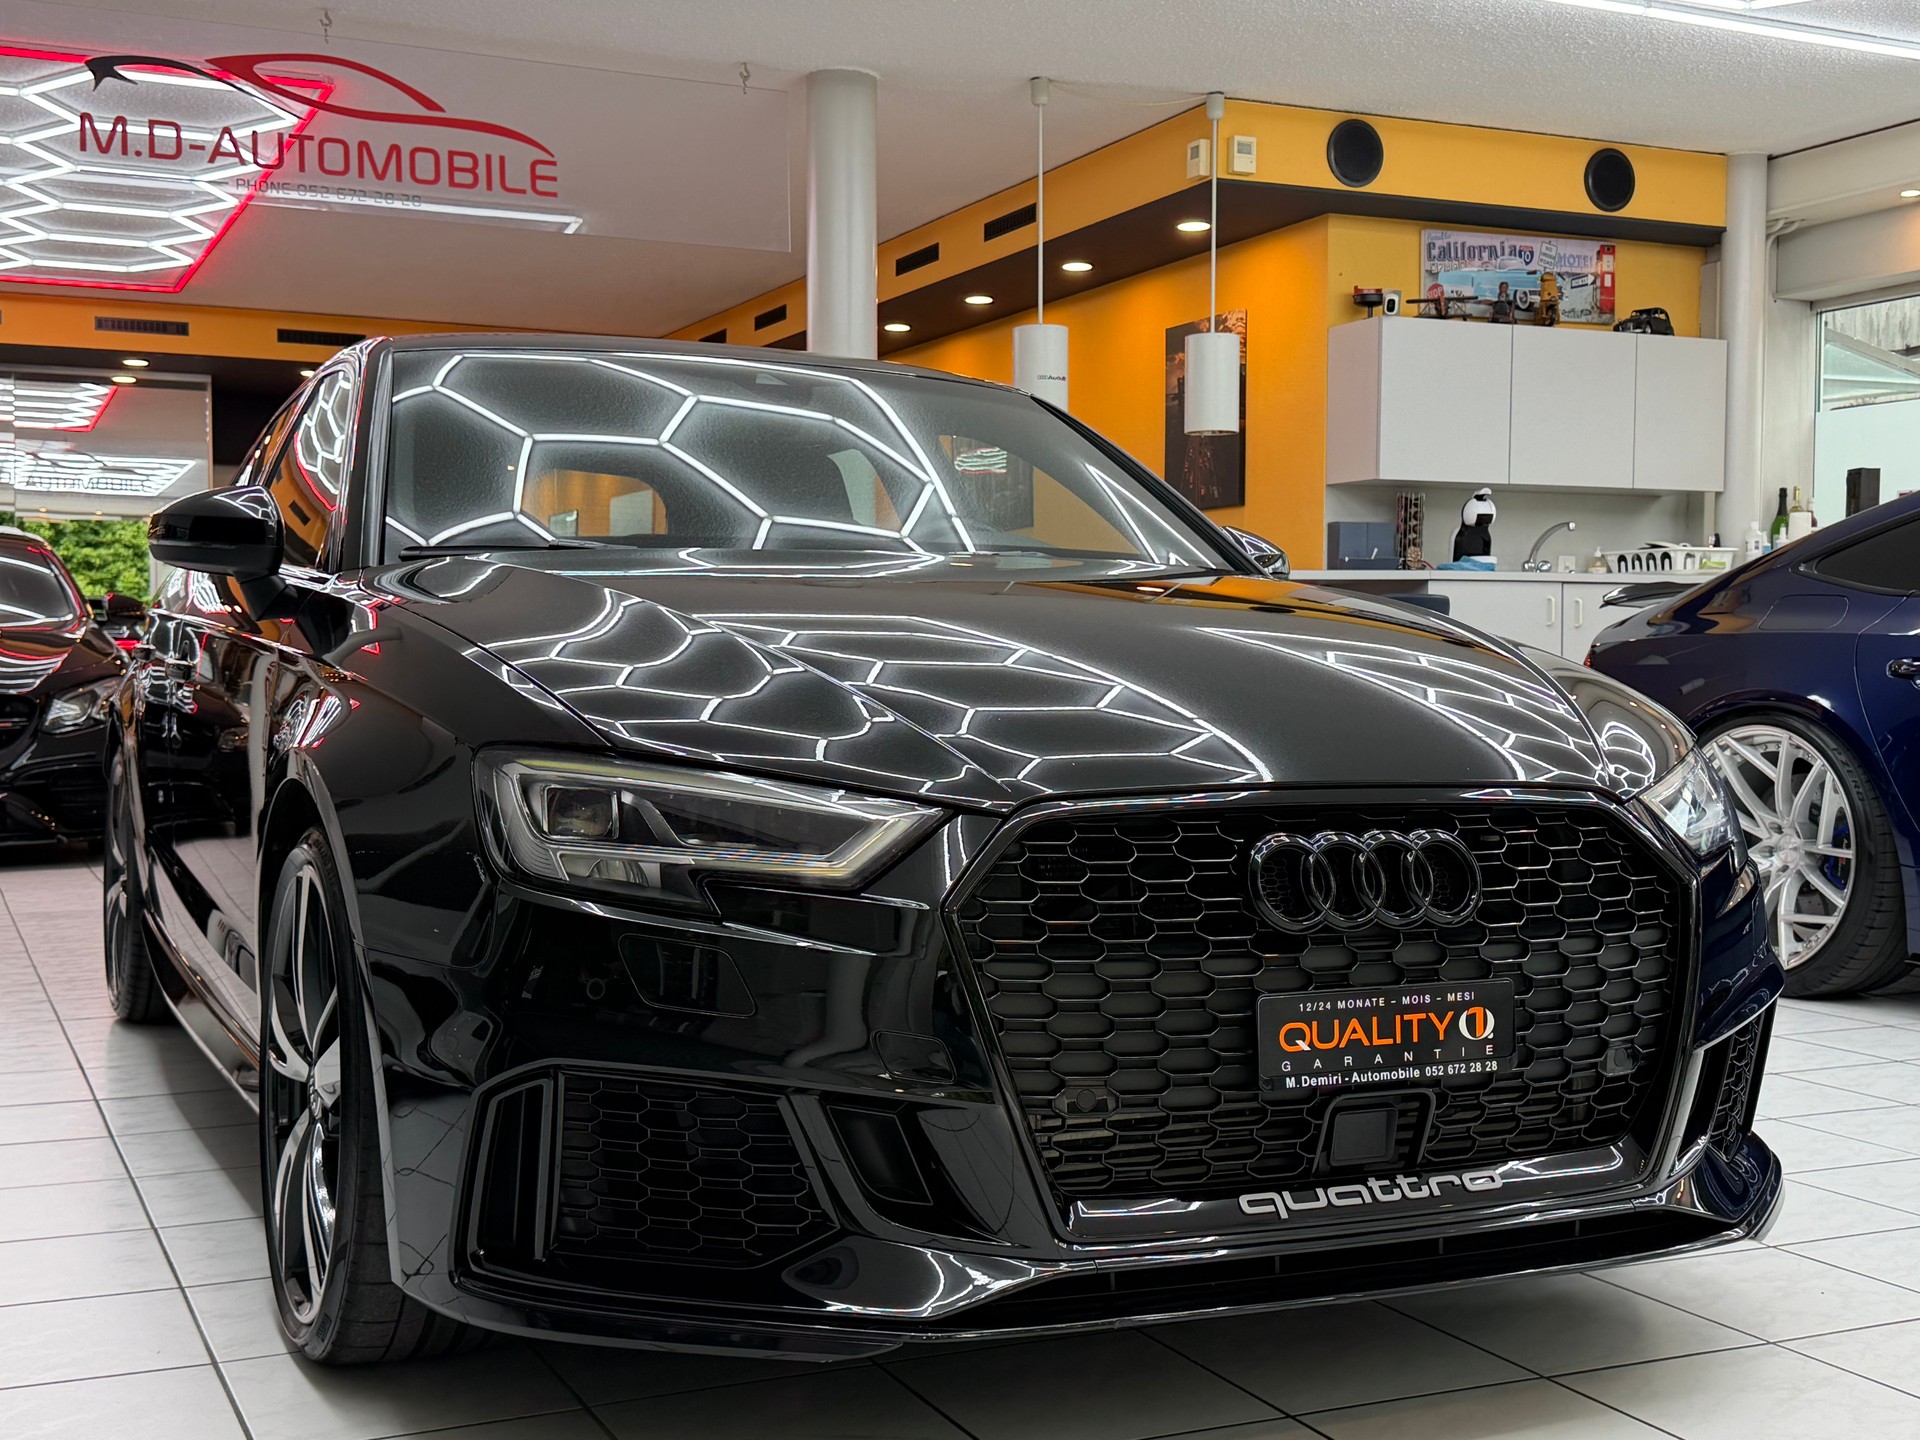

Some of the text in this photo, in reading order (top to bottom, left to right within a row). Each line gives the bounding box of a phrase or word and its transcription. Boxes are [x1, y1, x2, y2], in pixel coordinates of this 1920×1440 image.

[79, 111, 559, 198] M.D-AUTOMOBILE
[235, 178, 292, 196] PHONE
[296, 183, 330, 199] 052
[336, 187, 367, 202] 672
[1427, 240, 1518, 262] California
[1521, 250, 1531, 262] 10
[1299, 1001, 1332, 1012] 12/24
[1337, 997, 1386, 1010] MONATE
[1402, 995, 1432, 1005] MOIS
[1447, 991, 1475, 1002] MESI
[1279, 1010, 1455, 1053] QUALITY
[1281, 1045, 1494, 1072] GARANTIE
[1425, 1065, 1445, 1077] 052
[1447, 1063, 1467, 1075] 672
[1470, 1062, 1482, 1073] 28
[1485, 1060, 1498, 1072] 28
[1238, 1169, 1503, 1220] quattro
